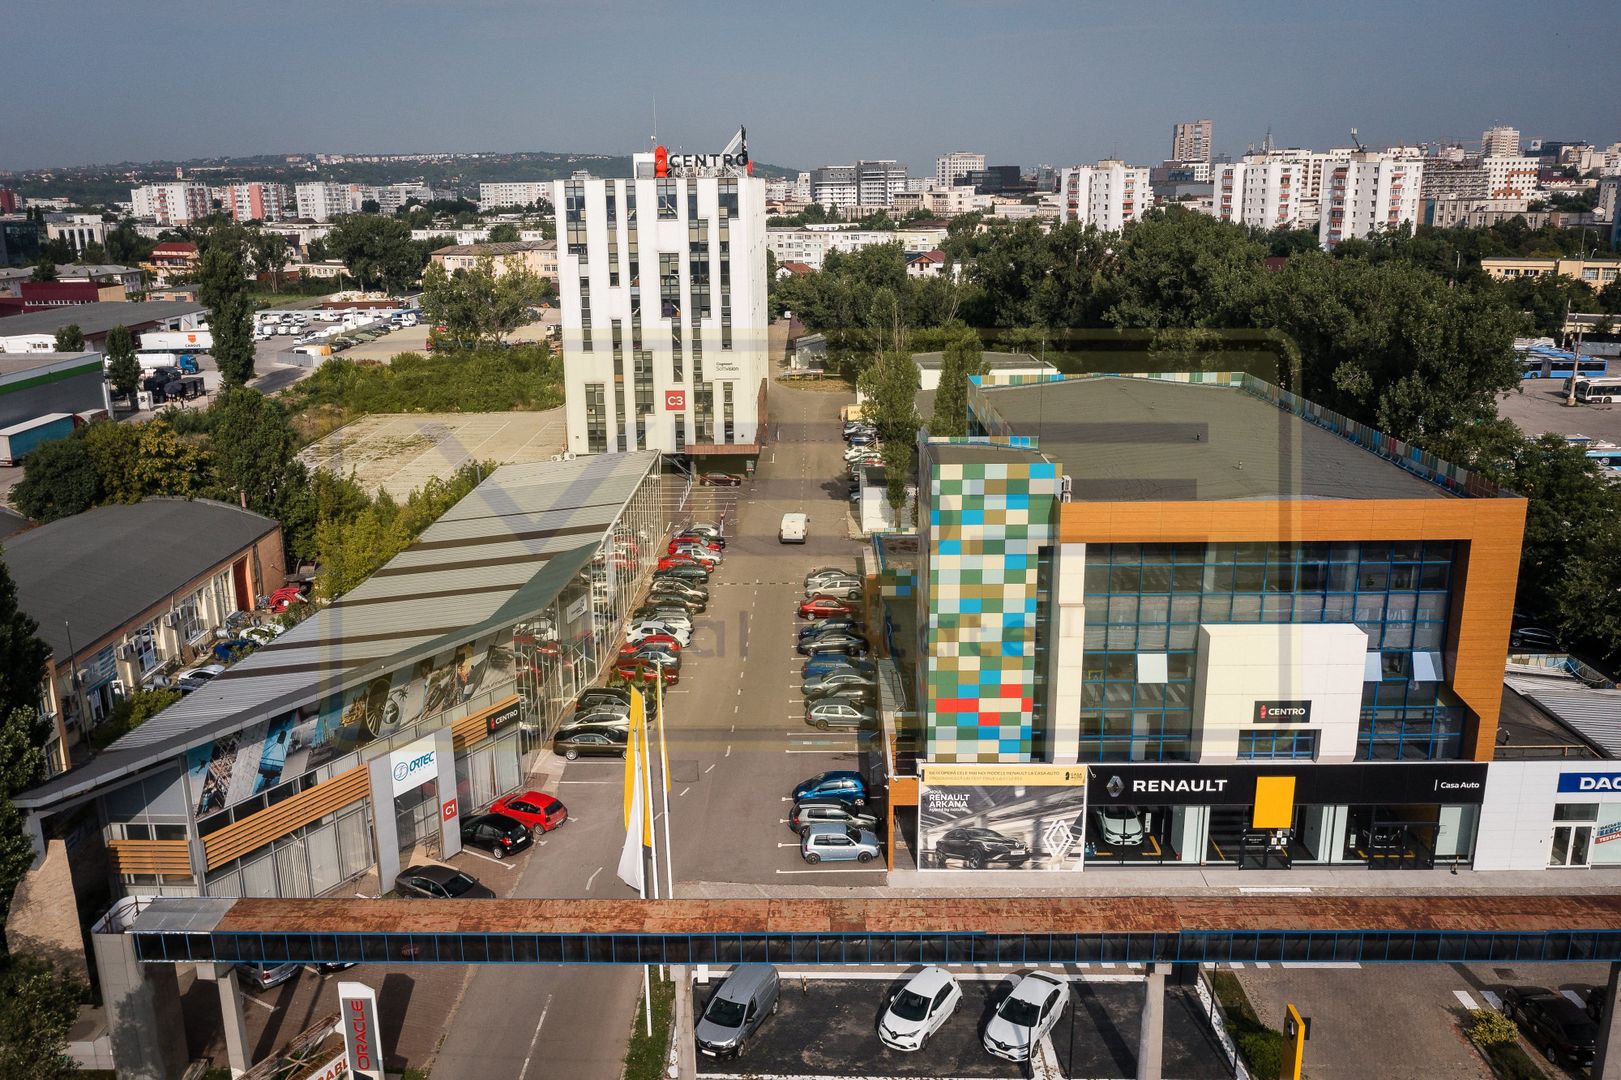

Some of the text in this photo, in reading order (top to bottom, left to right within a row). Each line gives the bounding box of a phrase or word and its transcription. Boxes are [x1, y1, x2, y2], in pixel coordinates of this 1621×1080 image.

[669, 153, 749, 168] CENTRO
[667, 395, 684, 406] C3
[495, 709, 518, 725] CENTRO
[1268, 708, 1306, 716] CENTRO
[409, 750, 435, 772] ORTEC
[1132, 779, 1228, 793] RENAULT
[1440, 781, 1480, 789] Casa Auto
[445, 803, 455, 815] C1
[351, 999, 370, 1070] ORACLE
